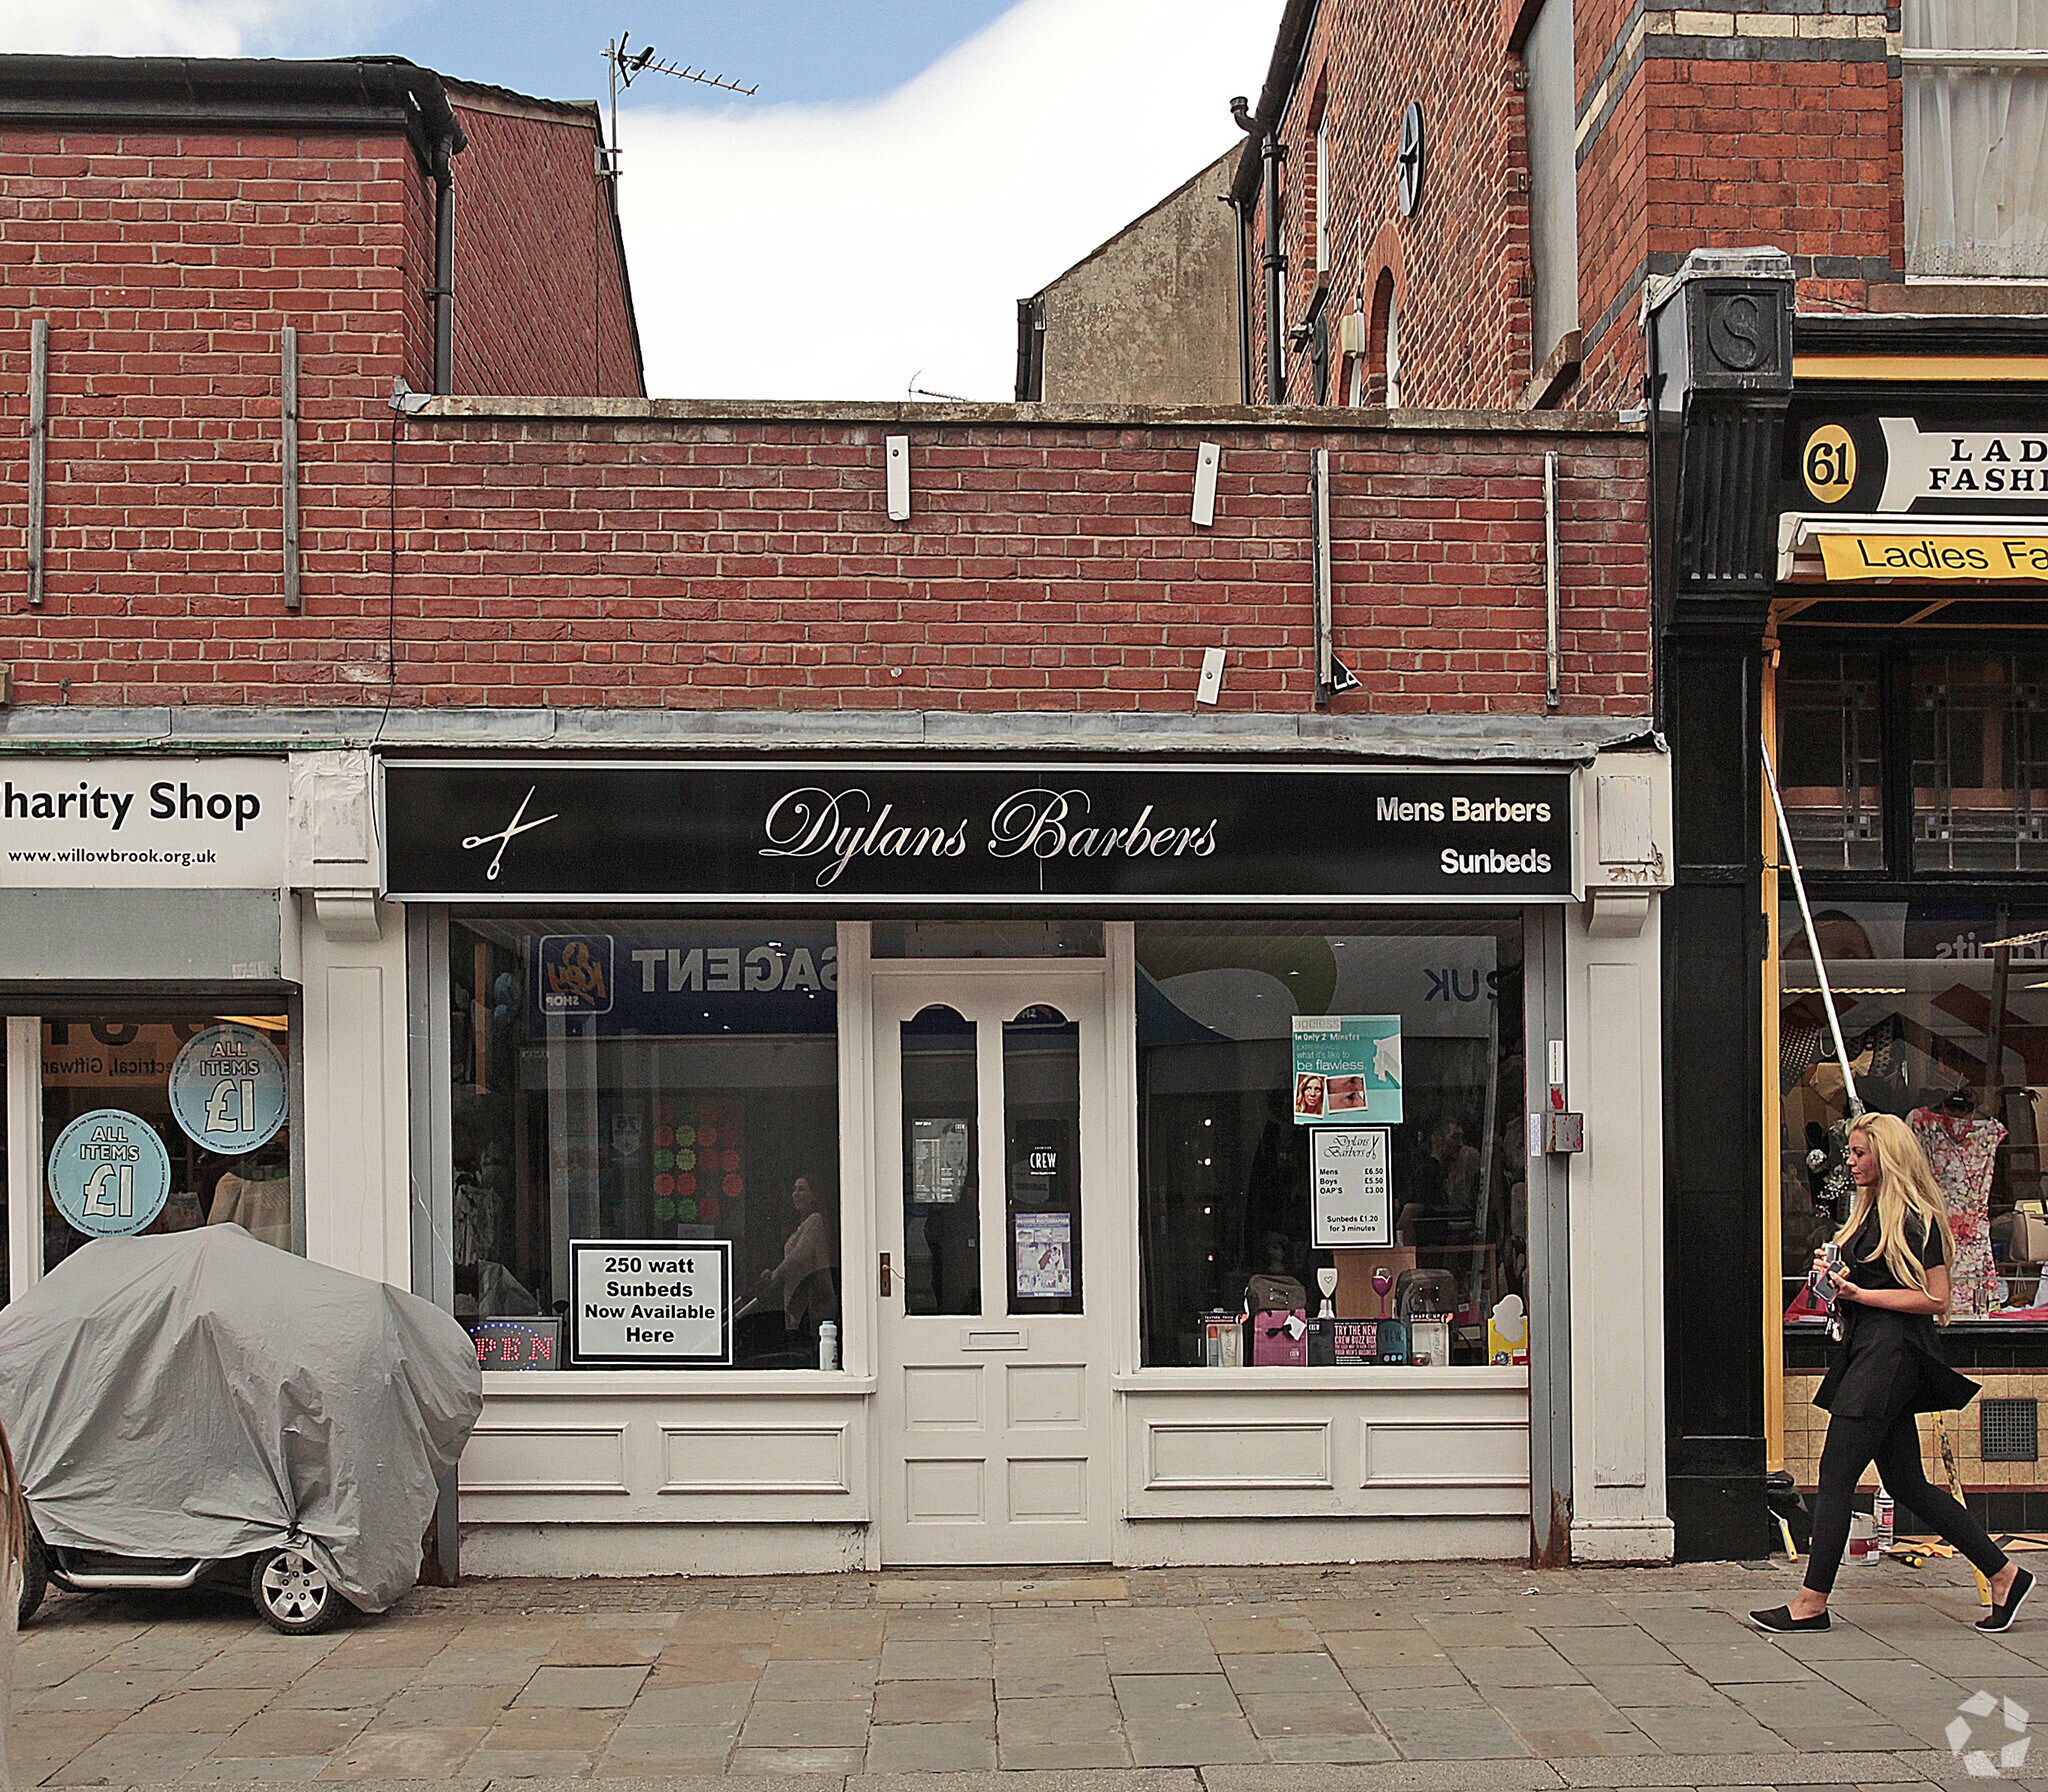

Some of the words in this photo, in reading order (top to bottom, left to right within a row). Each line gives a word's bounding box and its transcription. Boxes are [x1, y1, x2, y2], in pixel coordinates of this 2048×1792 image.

[1807, 443, 1849, 486] 61
[1857, 539, 1989, 569] Ladies
[0, 781, 134, 831] harity
[149, 781, 261, 831] Shop
[1377, 797, 1445, 823] Mens
[1452, 797, 1551, 823] Barbers
[758, 786, 969, 888] Dylans
[988, 788, 1217, 860] Barbers
[8, 848, 217, 867] www.willowbrook.org.uk
[1440, 848, 1551, 875] Sunbeds
[210, 1041, 247, 1058] ALL
[1297, 1051, 1314, 1059] what
[1316, 1051, 1326, 1059] it's
[1327, 1051, 1341, 1059] like
[1342, 1051, 1349, 1059] to
[200, 1059, 260, 1077] ITEMS
[1297, 1061, 1312, 1070] be
[205, 1078, 255, 1133] £1
[91, 1126, 128, 1142] ALL
[1333, 1135, 1369, 1147] Dylans
[80, 1144, 140, 1161] ITEMS
[1029, 1152, 1057, 1168] CREW
[1324, 1146, 1365, 1158] Barbers
[82, 1163, 134, 1217] £1
[604, 1257, 642, 1274] 250
[648, 1257, 695, 1274] watt
[605, 1280, 693, 1298] Sunbeds
[584, 1304, 627, 1320] Now
[630, 1303, 716, 1320] Available
[625, 1326, 675, 1343] Here
[1335, 1326, 1347, 1335] TRY
[1349, 1326, 1361, 1335] THE
[1363, 1326, 1377, 1335] NEW
[1335, 1336, 1349, 1344] CREW
[1352, 1336, 1364, 1344] BUZZ
[1366, 1336, 1376, 1344] BOX
[475, 1337, 554, 1361] PEN
